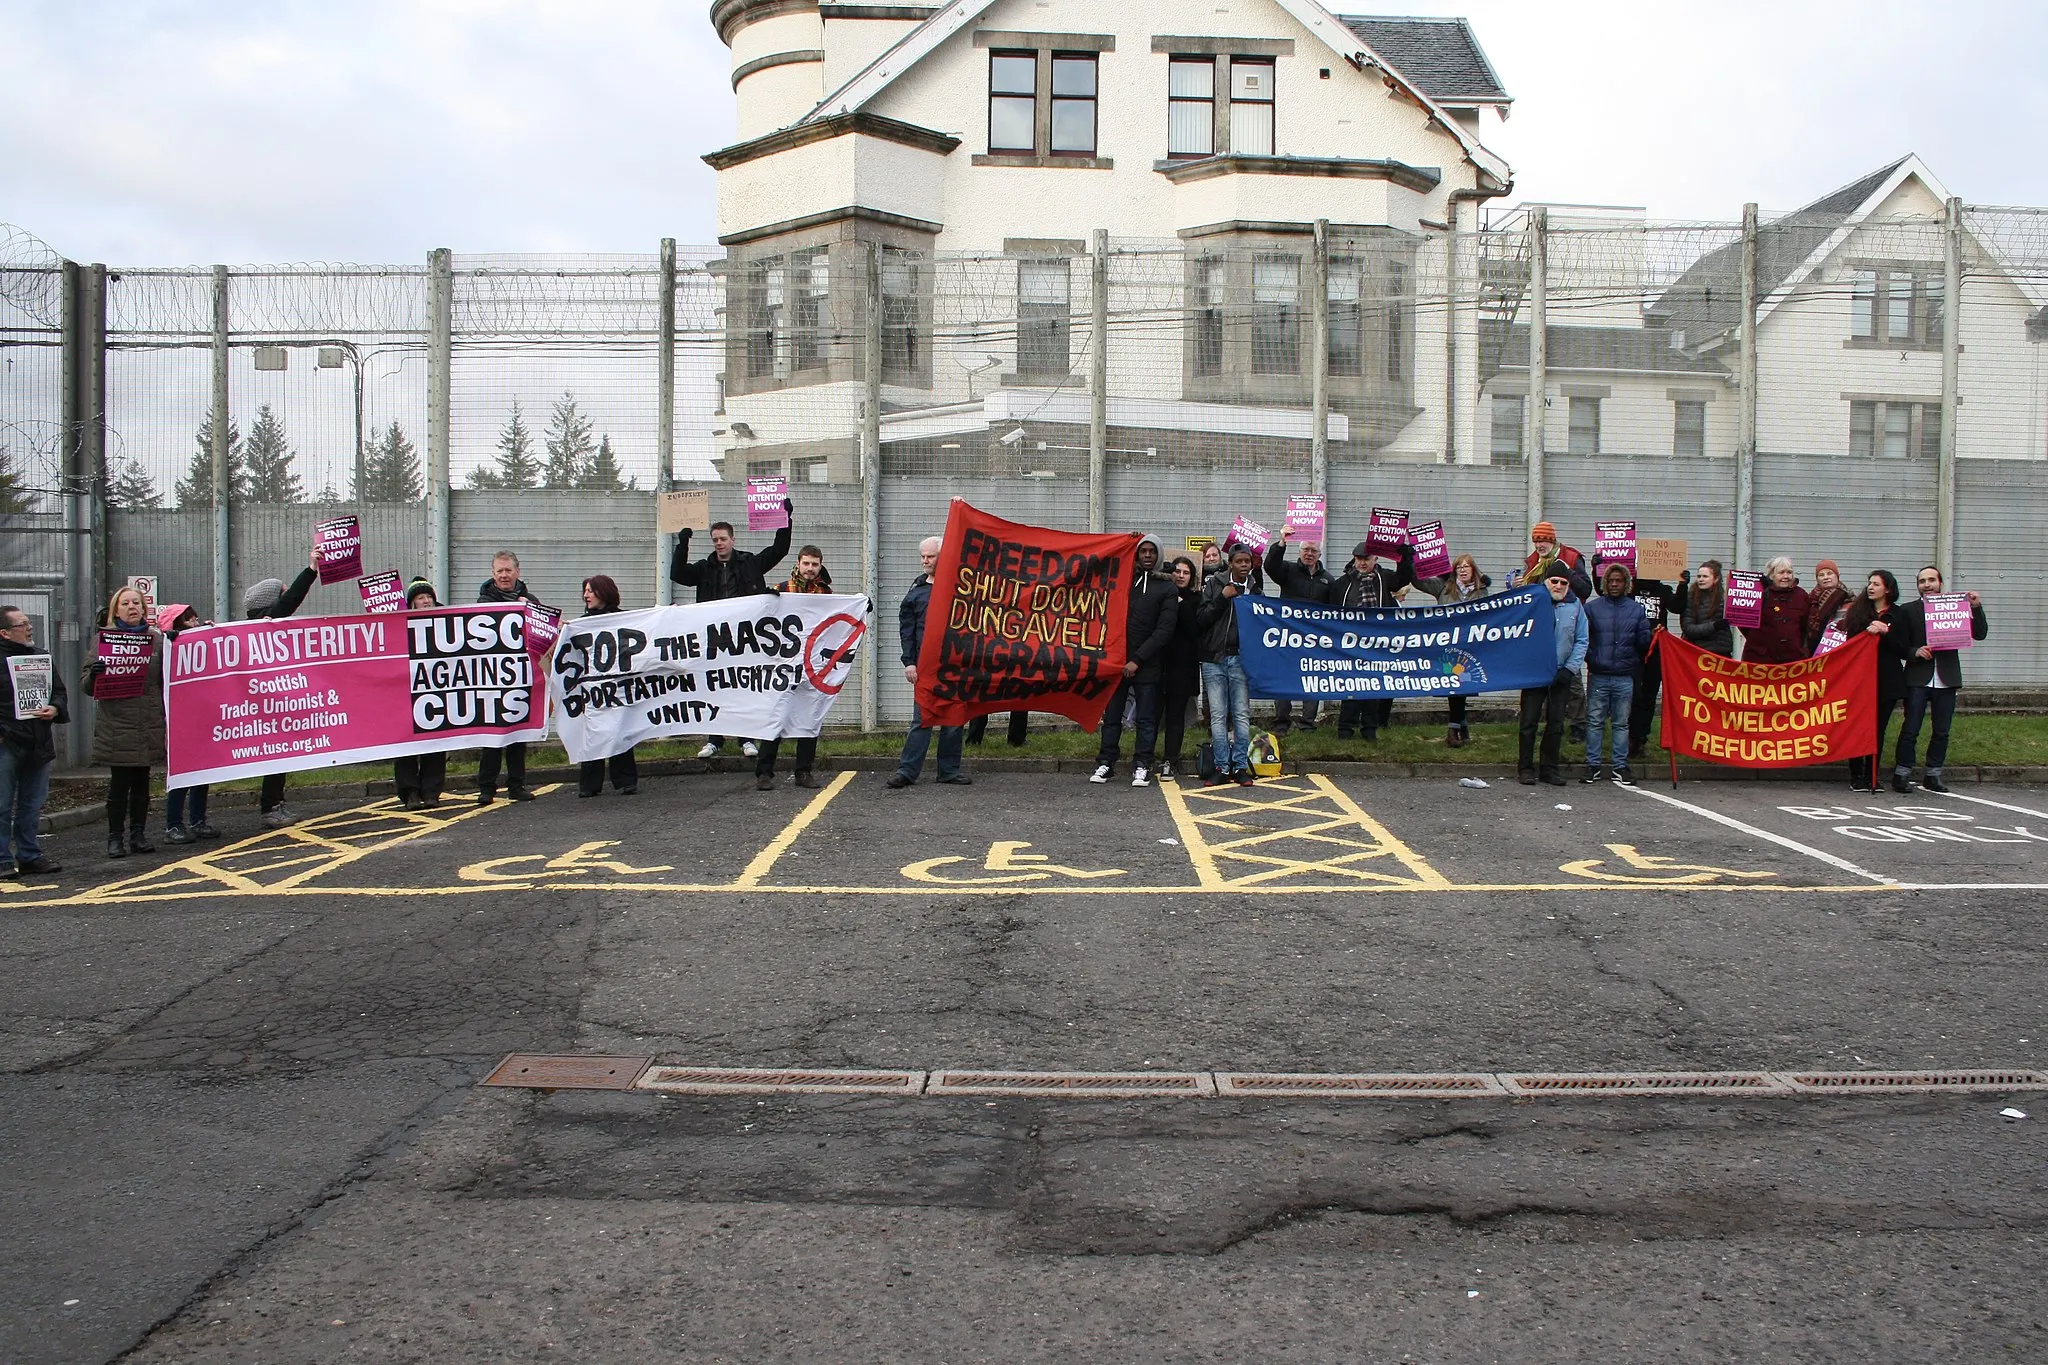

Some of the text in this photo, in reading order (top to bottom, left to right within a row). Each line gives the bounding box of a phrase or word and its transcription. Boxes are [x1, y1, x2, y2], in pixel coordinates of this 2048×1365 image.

[756, 485, 778, 493] END
[747, 493, 787, 502] DETENTION
[755, 502, 781, 510] NOW
[1243, 522, 1263, 535] END
[1379, 517, 1400, 526] END
[324, 528, 349, 540] END
[1233, 523, 1269, 545] DETENTION
[1369, 525, 1407, 535] DETENTION
[1417, 532, 1436, 542] END
[1604, 531, 1626, 539] END
[320, 536, 360, 551] ETENTION
[1235, 533, 1260, 549] NOW
[1374, 534, 1400, 543] NOW
[1415, 538, 1446, 552] ETENTION
[1596, 540, 1635, 548] DETENTION
[1656, 540, 1668, 548] NO
[324, 548, 354, 561] NOW
[960, 528, 1120, 590] FREEDOM!
[1418, 547, 1441, 560] NOW
[1602, 549, 1629, 557] NOW
[1640, 550, 1684, 558] INDEFINITE
[1644, 558, 1684, 566] DETENTION
[368, 583, 391, 595] END
[1736, 580, 1755, 588] END
[364, 590, 404, 608] DETENTION
[957, 567, 1108, 620] SHUT DOWN
[1728, 588, 1762, 599] DETENTION
[371, 602, 399, 613] NOW
[1252, 593, 1532, 621] No Detention No Deportations
[1732, 598, 1756, 607] NOW
[1934, 602, 1958, 611] END
[532, 611, 549, 622] END
[1925, 611, 1969, 620] DETENTION
[525, 615, 558, 634] DETENTION
[950, 599, 1107, 651] DUNGAVEL!
[1932, 620, 1962, 629] NOW
[407, 613, 524, 654] TUSC
[531, 626, 553, 640] NOW
[1262, 619, 1534, 653] Close Dungavel Now!
[1832, 632, 1847, 642] EN
[112, 645, 140, 654] END
[176, 621, 385, 676] NO TO AUSTERITY!
[555, 614, 803, 692] STOP THE MASS
[940, 630, 1107, 682] MIGRANT
[106, 666, 140, 675] NOW
[1300, 658, 1430, 673] Glasgow Campaign to
[1697, 654, 1830, 681] GLASGOW
[412, 656, 530, 691] AGAINST
[707, 663, 803, 693] FLIGHTS!
[248, 673, 308, 694] Scottish
[1301, 675, 1460, 693] Welcome Refugees
[18, 689, 48, 700] CLOSE THE
[1698, 678, 1827, 706] CAMPAIGN
[19, 700, 42, 710] CAMPS
[220, 689, 339, 720] Trade Unionist &
[413, 689, 530, 730] CUTS
[647, 701, 720, 725] UNITY
[1680, 695, 1848, 733] TO WELCOME
[213, 712, 348, 742] Socialist Coalition
[232, 734, 330, 759] www.tusc.org.uk
[1692, 730, 1829, 761] REFUGEES
[1777, 806, 1974, 822] BUS
[1831, 825, 2048, 842] ONLY
